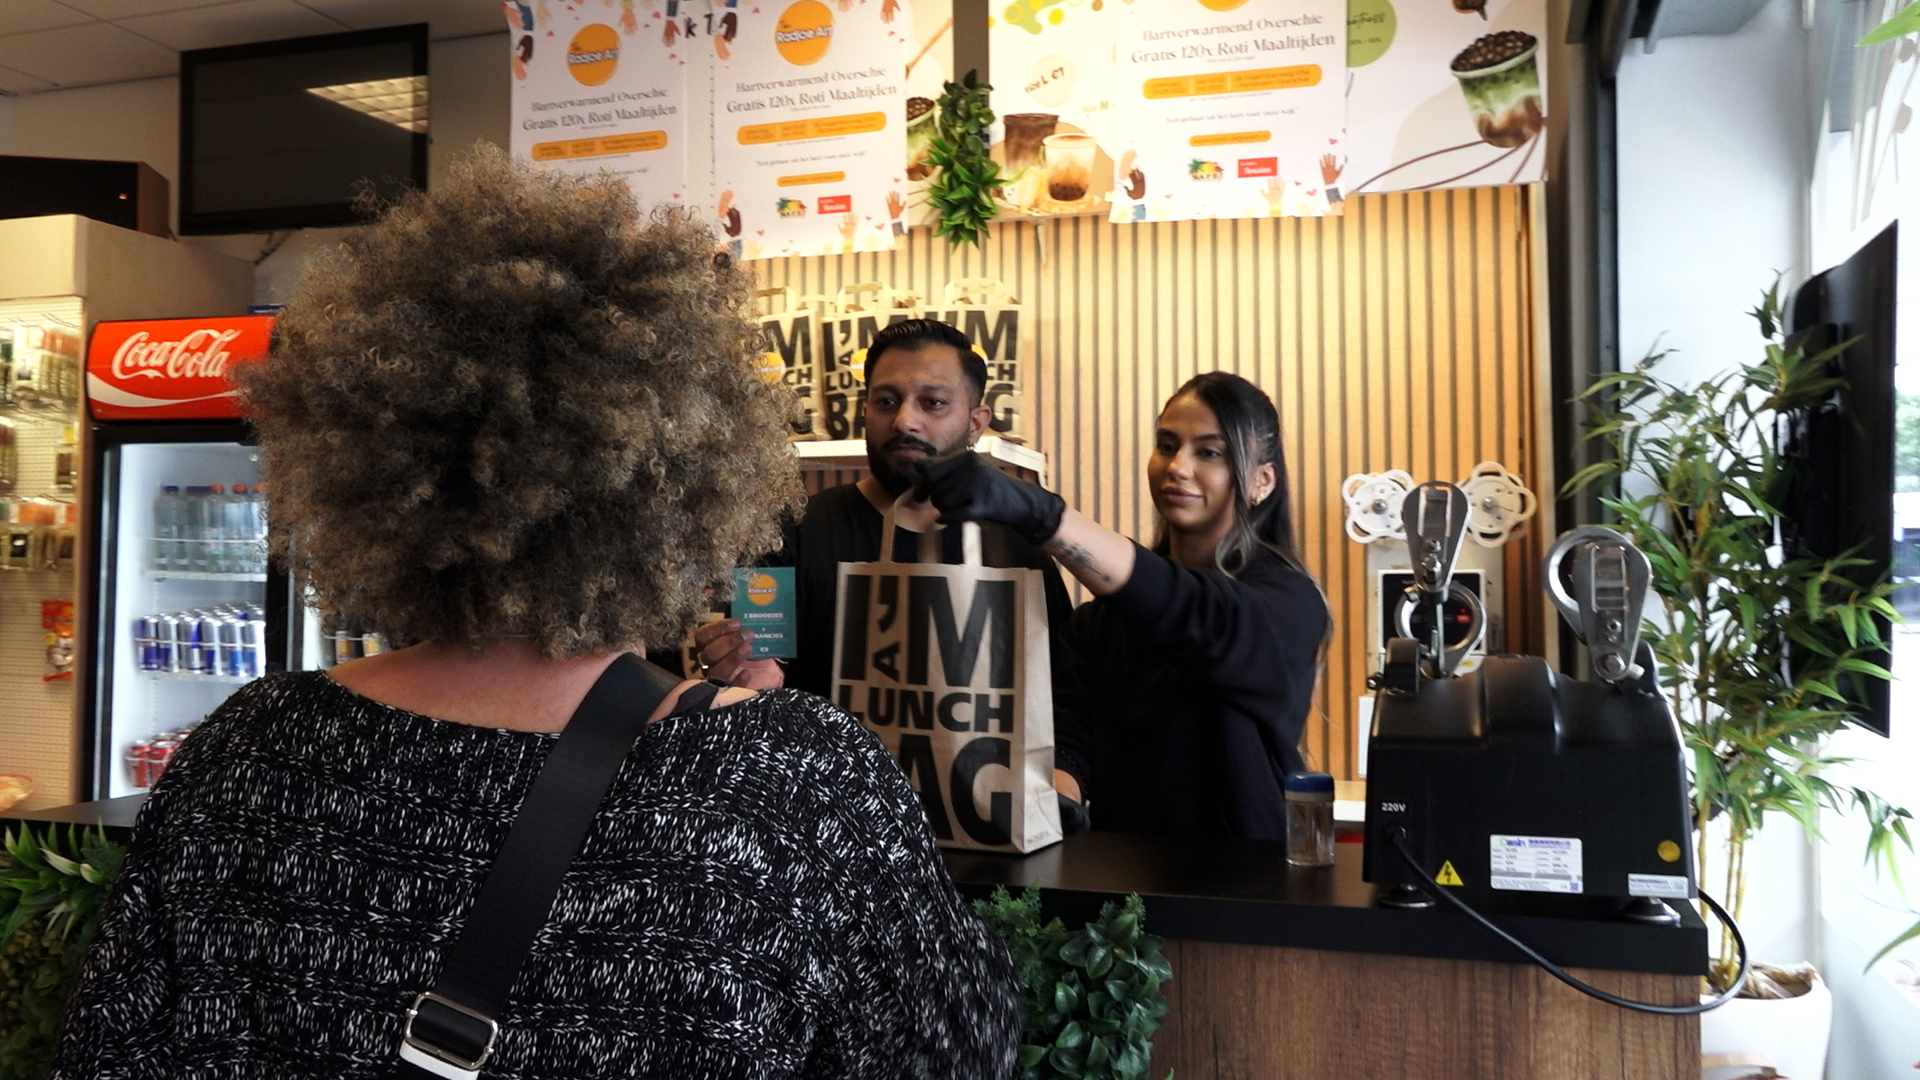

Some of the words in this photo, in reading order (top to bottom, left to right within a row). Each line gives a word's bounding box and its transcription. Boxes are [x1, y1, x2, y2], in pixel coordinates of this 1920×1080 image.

[1256, 13, 1324, 30] Overschie
[1131, 48, 1177, 64] Gratis
[1217, 41, 1250, 57] Roti
[1253, 32, 1336, 53] Maaltijden
[726, 99, 767, 114] Gratis
[799, 91, 827, 106] Roti
[522, 117, 559, 131] Gratis
[111, 329, 243, 380] Coca-Cola
[840, 573, 1017, 690] I'M
[838, 684, 1014, 734] LUNCH
[890, 730, 1013, 847] AG
[1381, 801, 1406, 813] 220V
